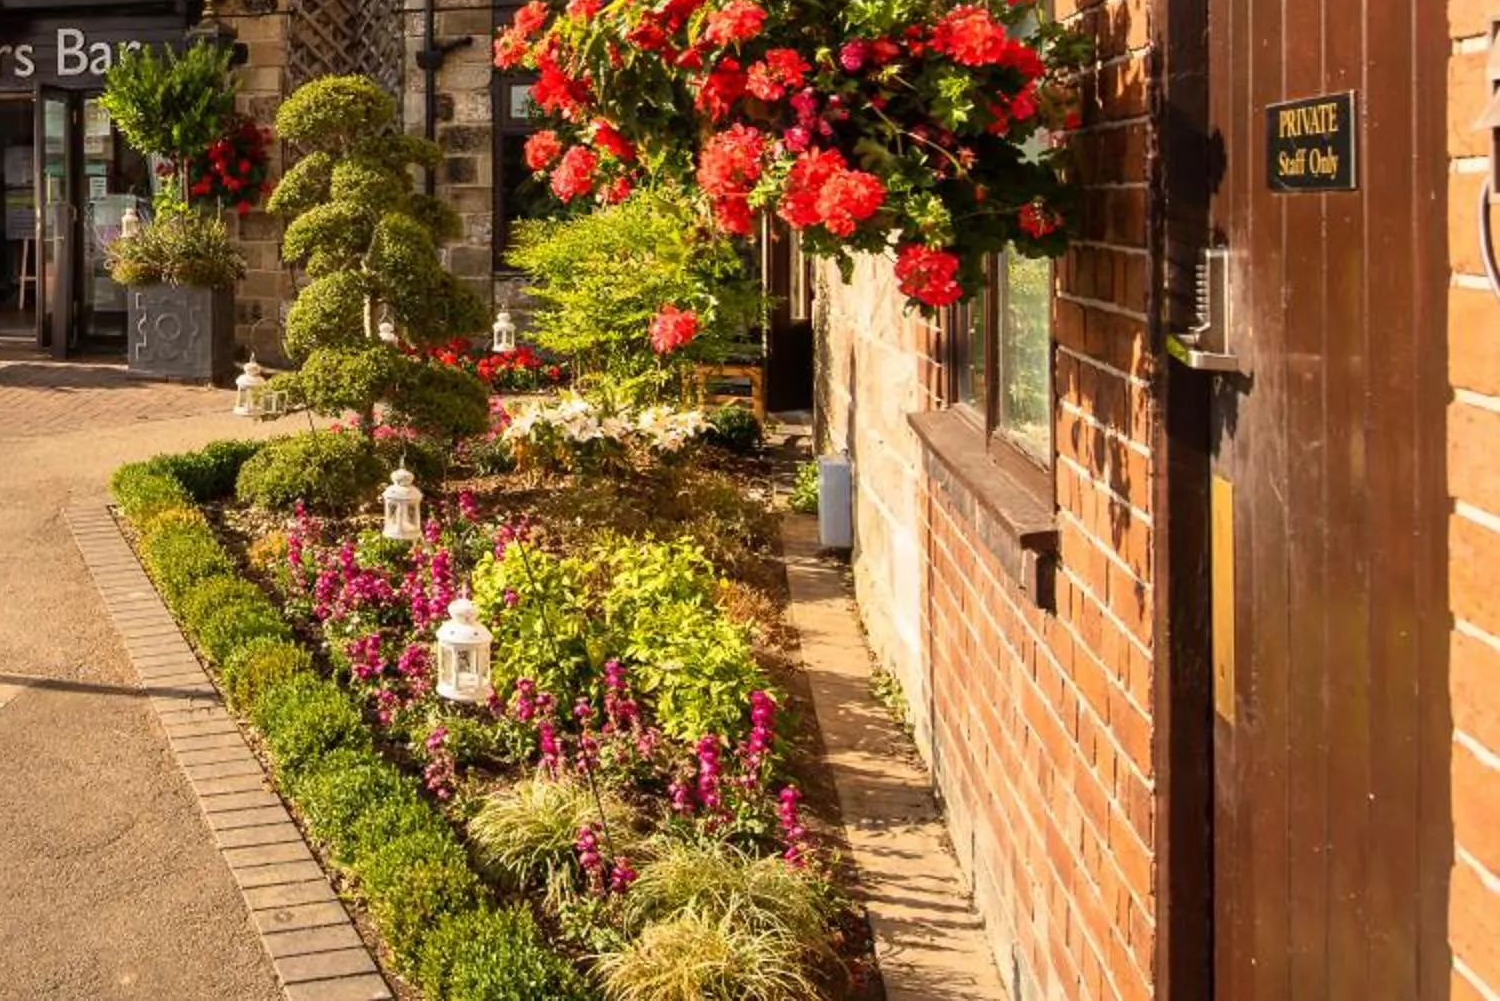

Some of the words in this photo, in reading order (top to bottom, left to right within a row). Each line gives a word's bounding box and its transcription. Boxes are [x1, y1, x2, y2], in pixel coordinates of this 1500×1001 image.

[1279, 102, 1339, 138] PRIVATE
[1279, 148, 1307, 176] Staff
[1309, 146, 1338, 180] Only
